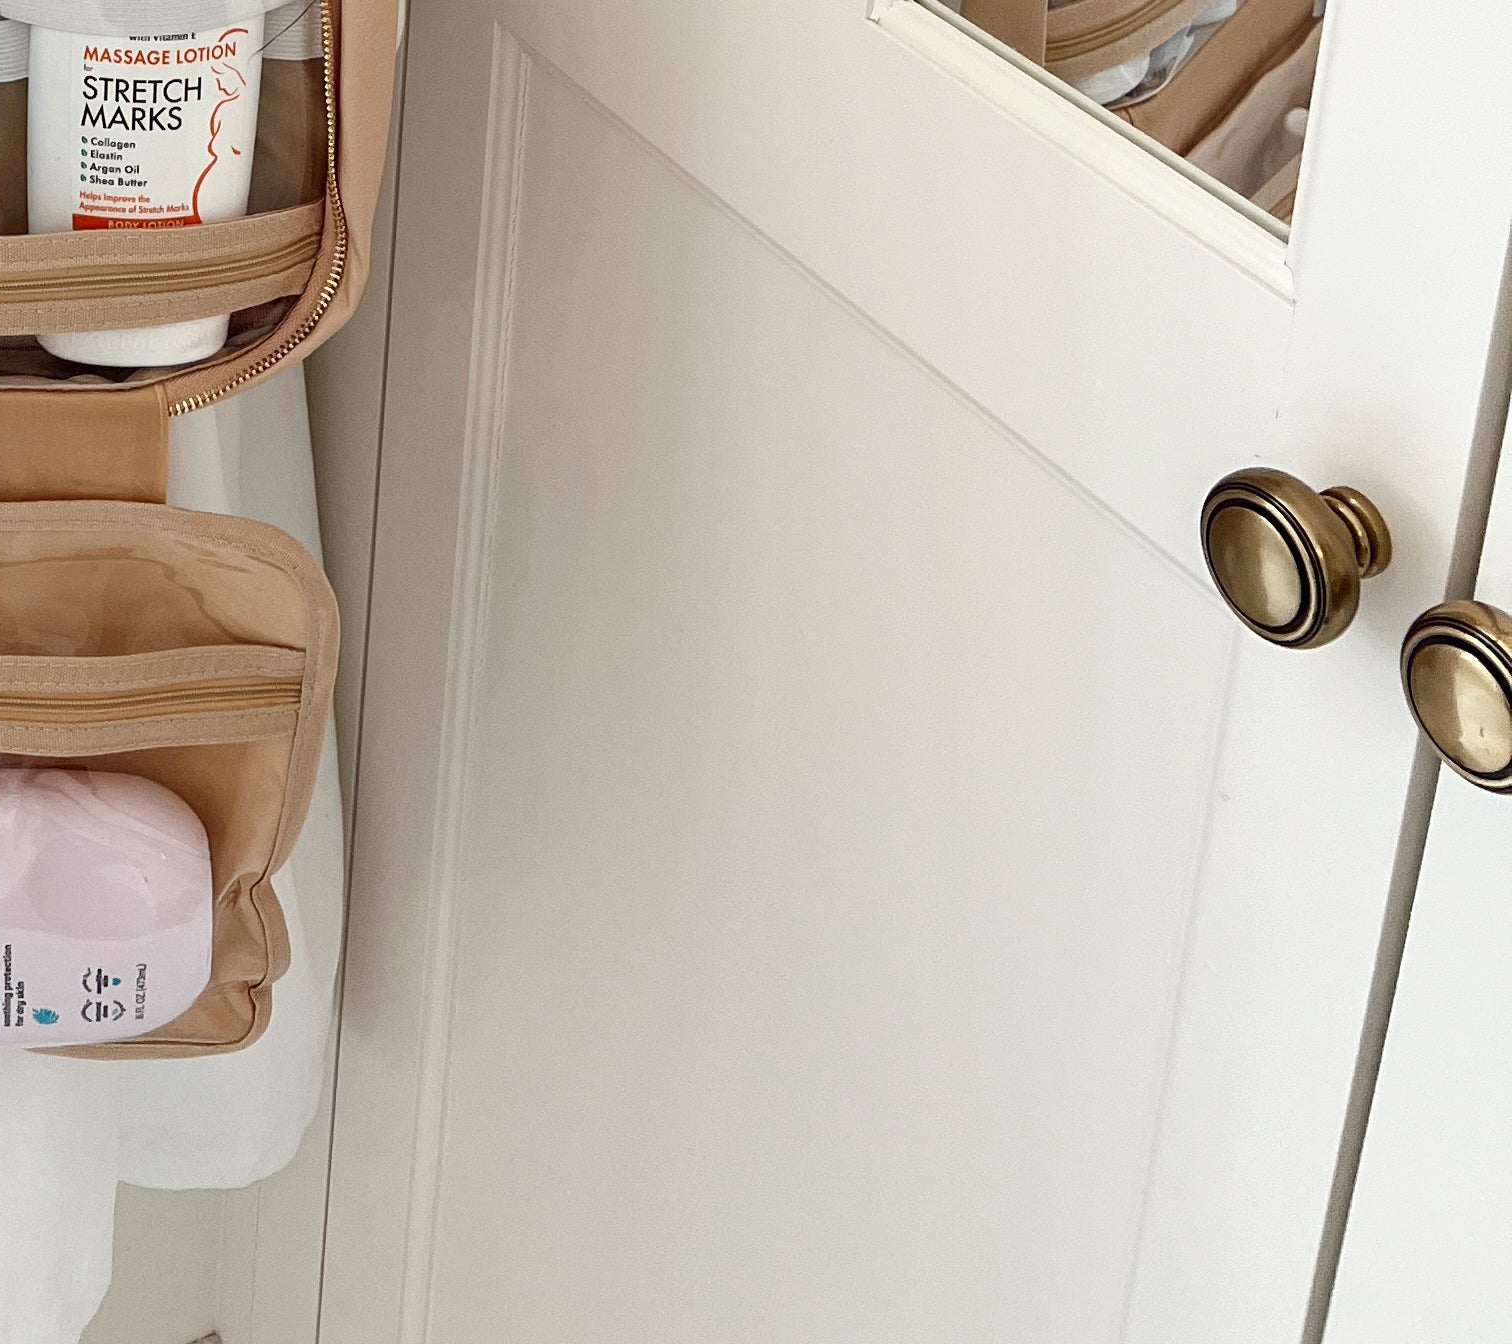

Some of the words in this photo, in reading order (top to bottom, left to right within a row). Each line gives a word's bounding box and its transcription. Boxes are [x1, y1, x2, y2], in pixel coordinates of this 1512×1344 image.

[83, 45, 171, 65] MASSAGE
[176, 41, 237, 64] LOTION
[82, 75, 202, 104] STRETCH
[80, 102, 183, 132] MARKS
[90, 137, 136, 150] Collagen
[90, 150, 123, 161] Elastin
[89, 162, 122, 175] Argan
[124, 164, 140, 174] Oil
[89, 175, 115, 186] Shea
[117, 176, 148, 187] Butter
[79, 190, 102, 203] Helps
